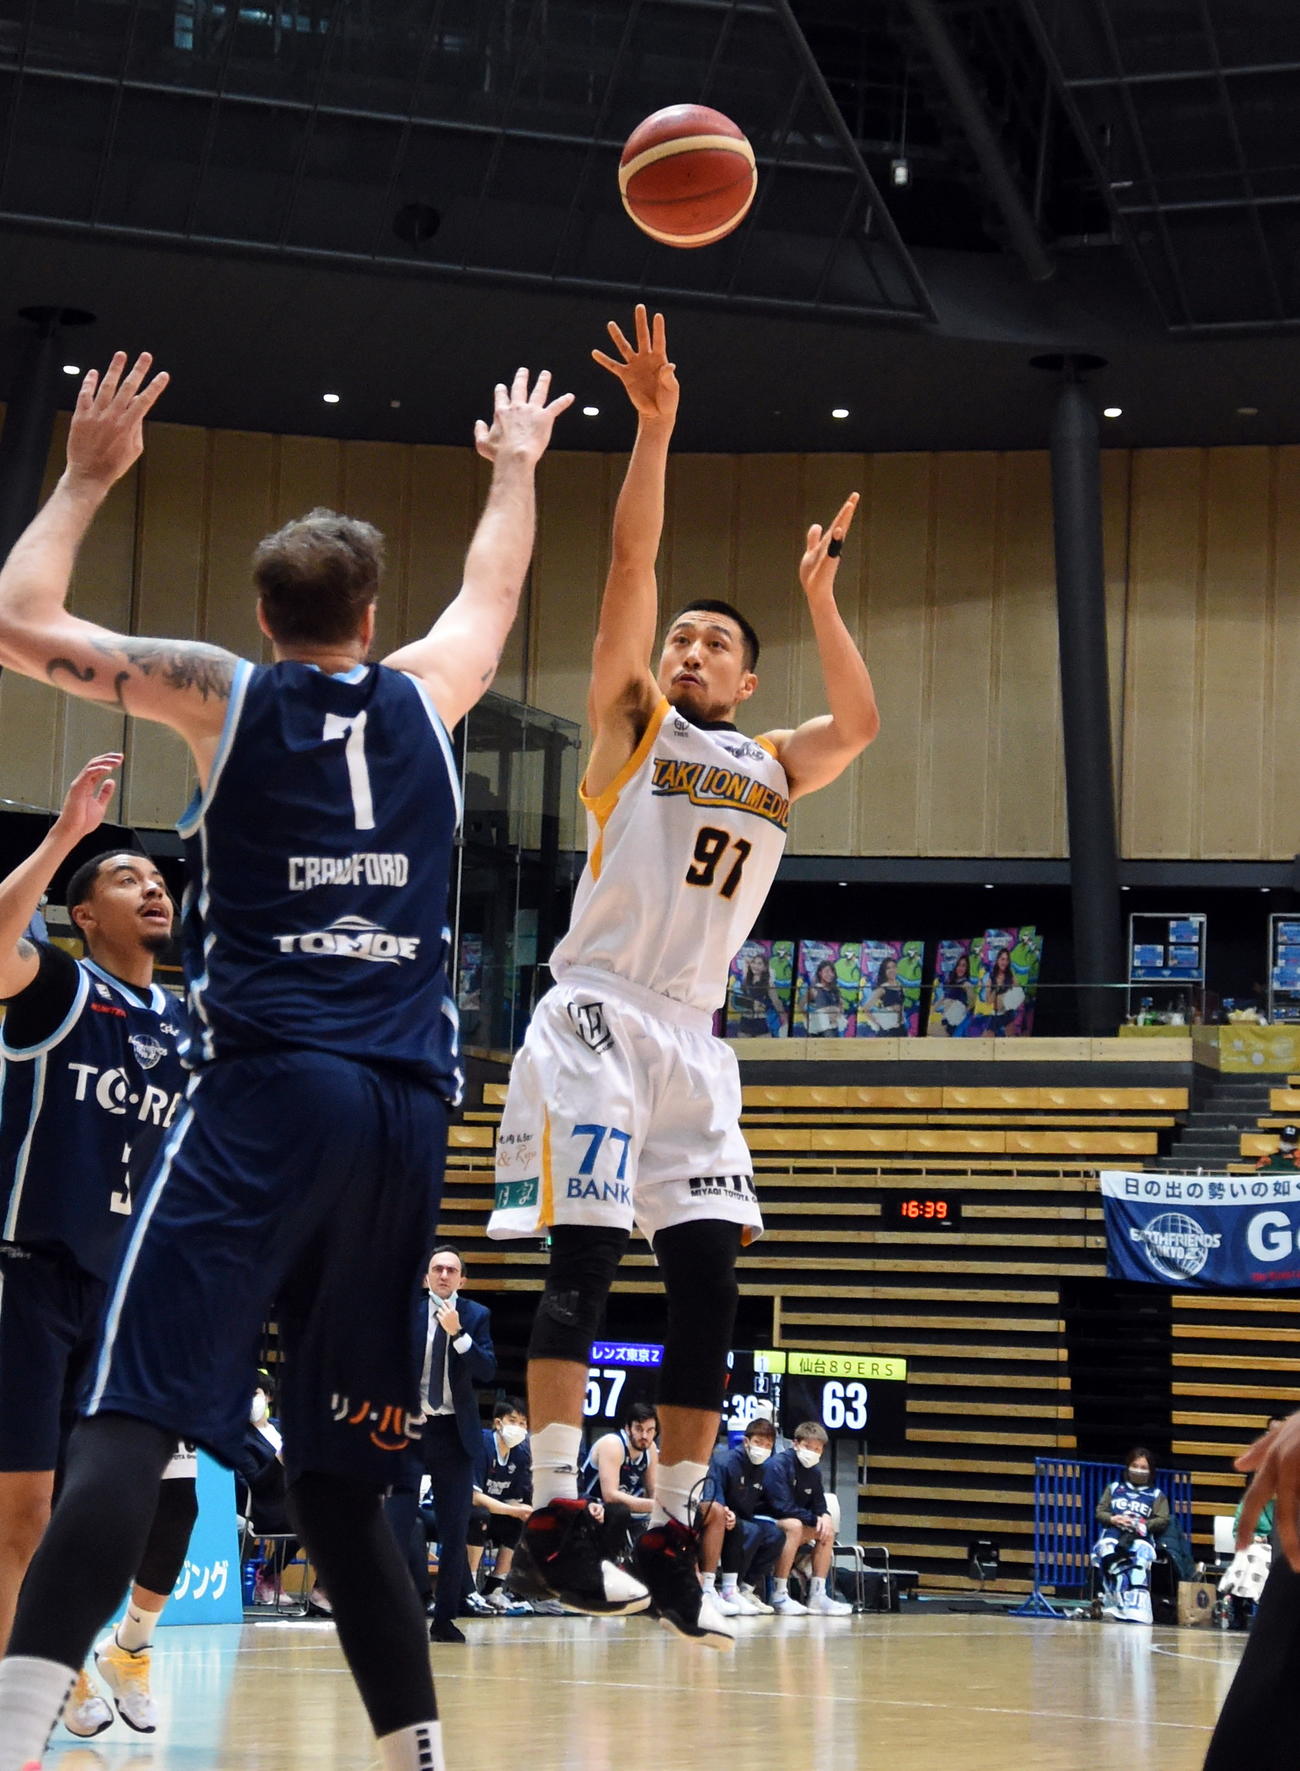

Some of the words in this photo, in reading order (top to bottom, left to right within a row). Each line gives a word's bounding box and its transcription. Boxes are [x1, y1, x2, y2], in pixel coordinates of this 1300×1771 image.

[288, 852, 410, 892] CRAWFORD
[685, 826, 753, 901] 91
[272, 930, 422, 962] TOMOE
[571, 1123, 633, 1182] 77
[566, 1177, 631, 1206] BANK
[690, 1187, 721, 1198] MIYAGI
[723, 1188, 749, 1202] TOYOTA
[901, 1200, 948, 1219] 16:39
[1247, 1210, 1300, 1262] G
[592, 1346, 660, 1363] レンズ東京Z
[583, 1368, 627, 1418] 57
[822, 1380, 868, 1430] 63
